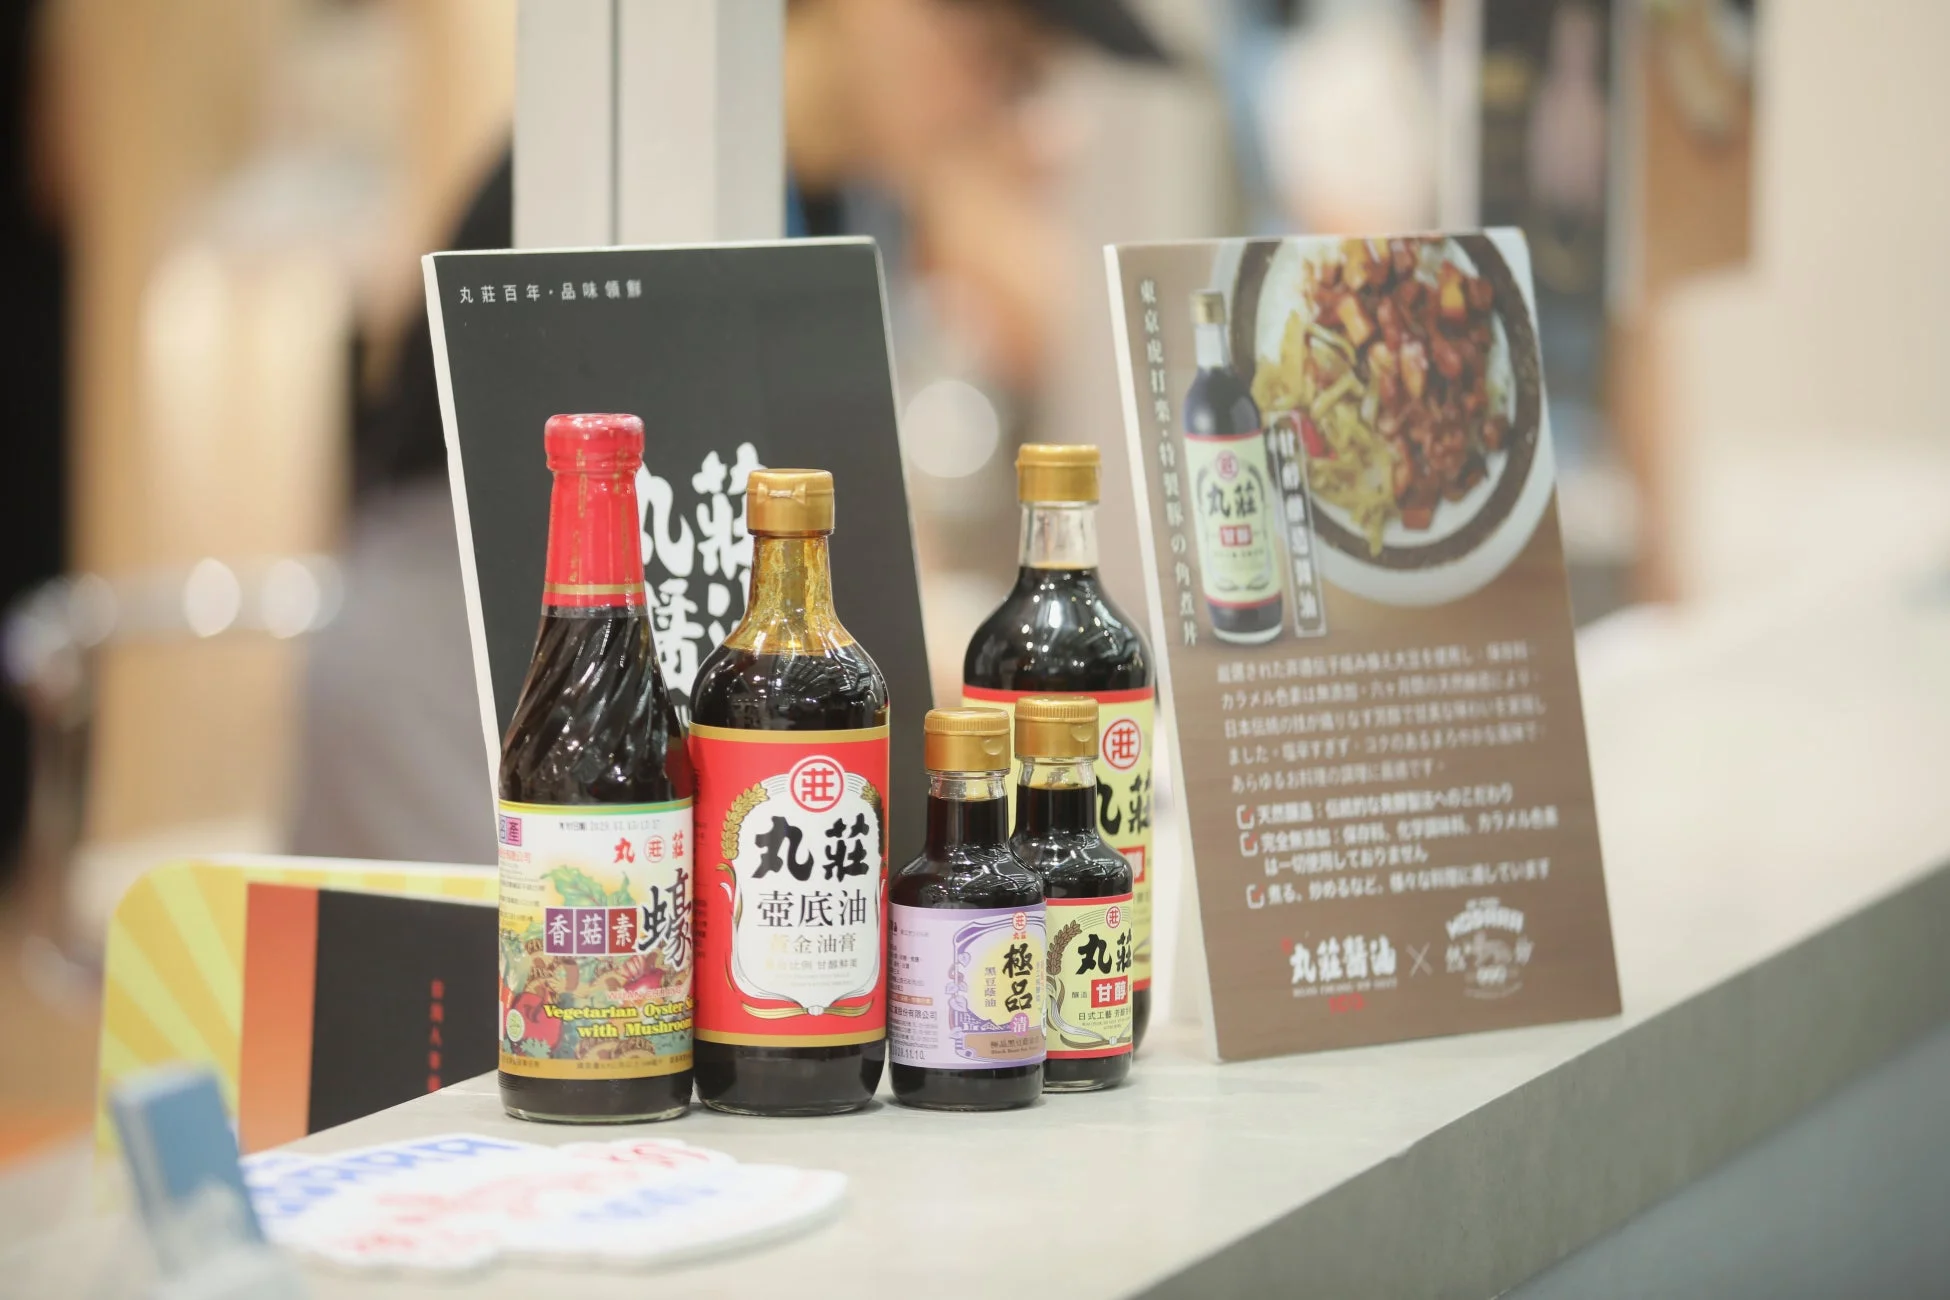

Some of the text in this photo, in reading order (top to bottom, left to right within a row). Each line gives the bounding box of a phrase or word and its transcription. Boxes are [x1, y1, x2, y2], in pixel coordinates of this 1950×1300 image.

[614, 838, 635, 864] 丸
[751, 812, 870, 883] 丸莊
[757, 889, 867, 927] 壺底油
[548, 913, 635, 947] 香菇素
[1075, 928, 1132, 975] 丸莊
[1002, 943, 1033, 1013] 極品
[1095, 980, 1127, 1003] 甘醇
[543, 1004, 638, 1022] Vegetarian
[644, 1002, 684, 1019] Oyster
[1012, 1018, 1027, 1034] 清
[577, 1025, 618, 1038] with
